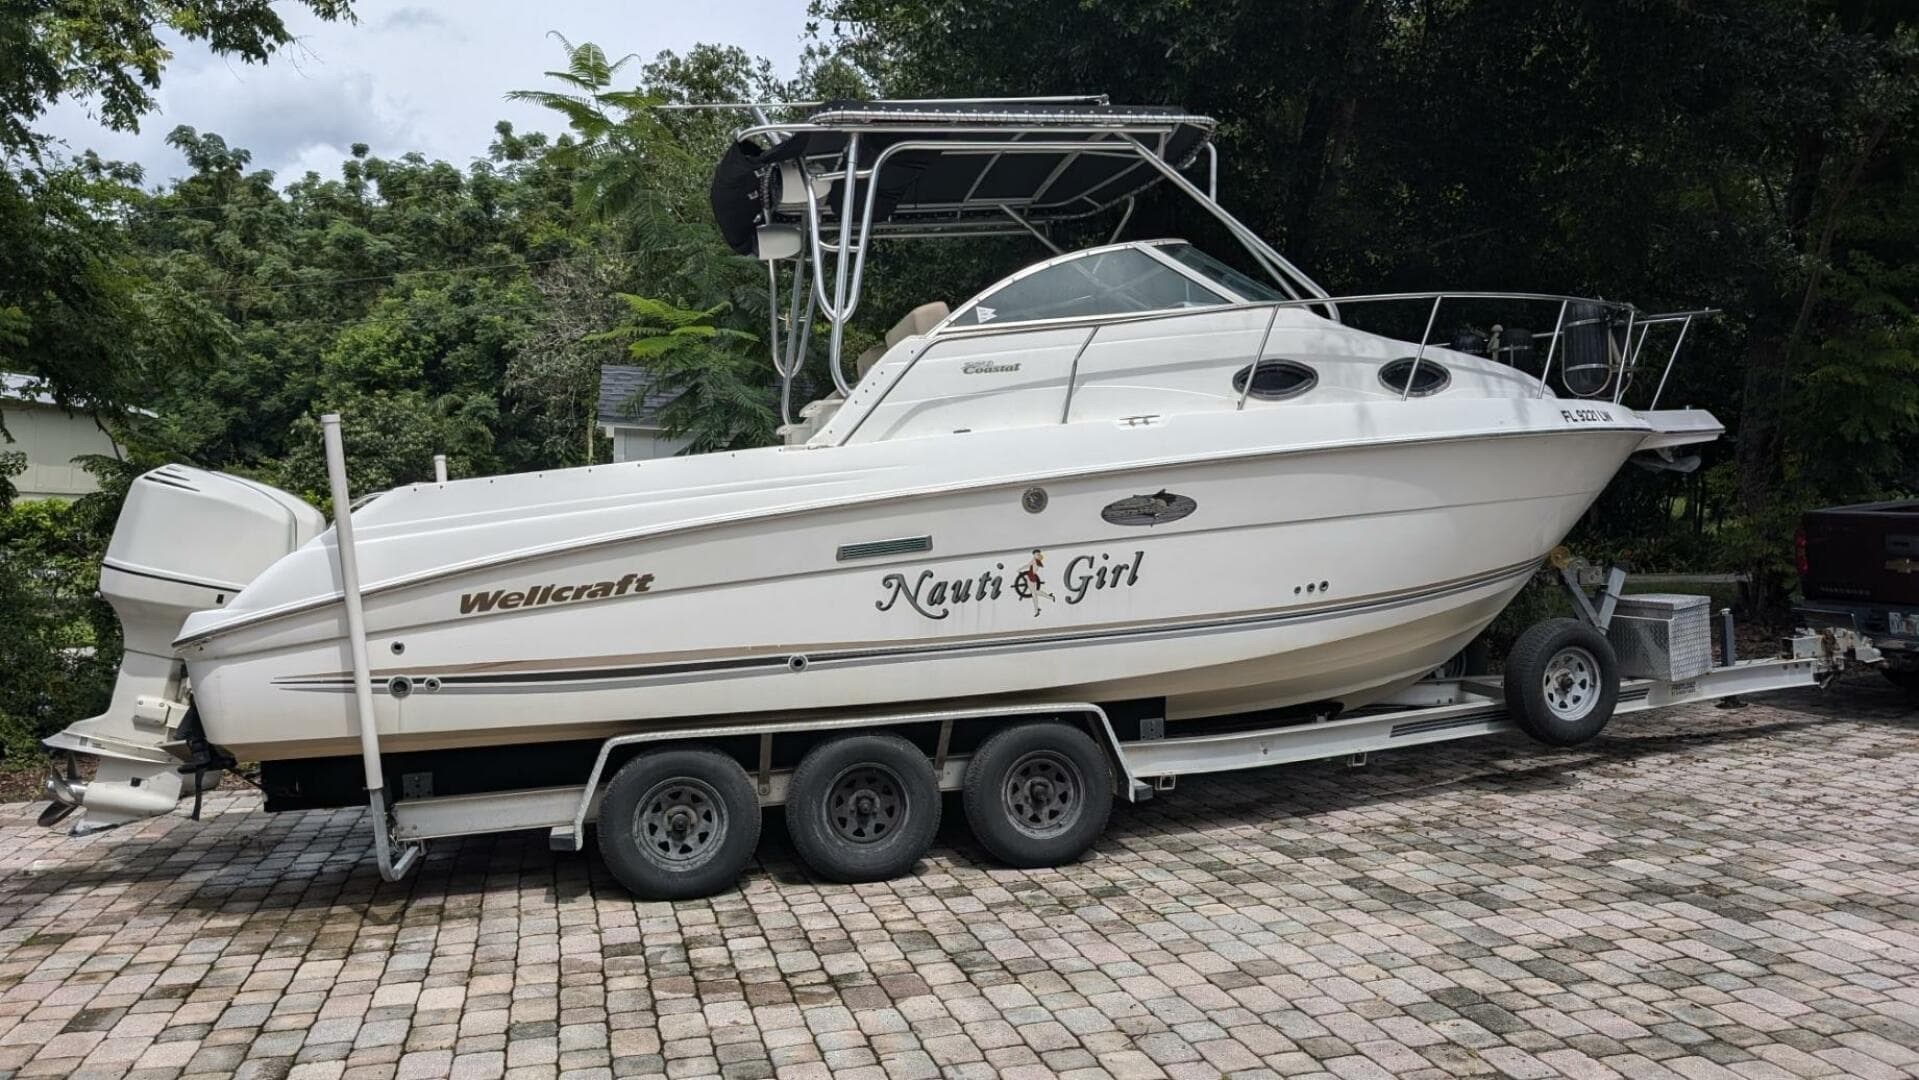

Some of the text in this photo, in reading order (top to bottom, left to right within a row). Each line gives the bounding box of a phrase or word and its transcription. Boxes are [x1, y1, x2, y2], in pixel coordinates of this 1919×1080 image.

[962, 363, 1021, 374] Coastal
[1560, 409, 1578, 423] FL
[1576, 409, 1601, 422] 9221
[460, 573, 655, 615] Wellcraft
[875, 551, 1144, 620] Nauti Girl
